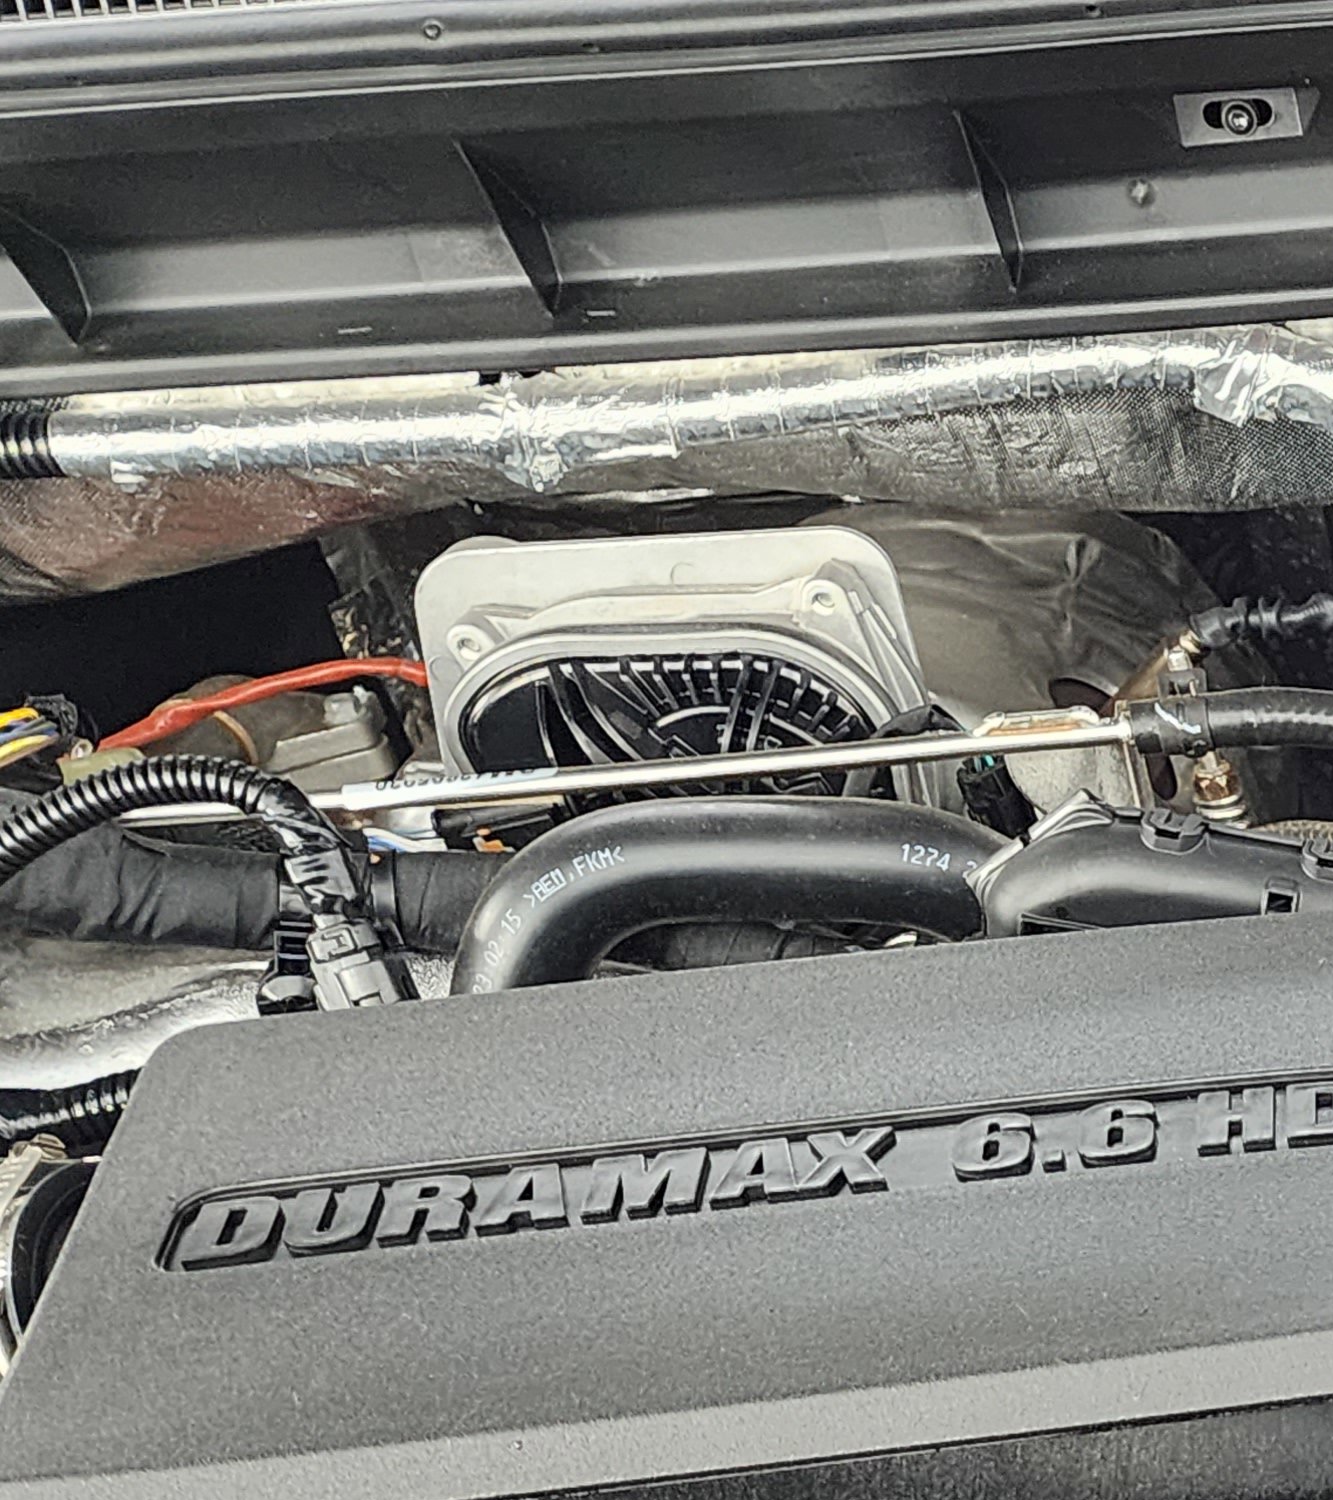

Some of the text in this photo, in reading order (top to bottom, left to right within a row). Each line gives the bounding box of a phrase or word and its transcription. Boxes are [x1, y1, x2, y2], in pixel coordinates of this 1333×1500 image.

[901, 843, 951, 872] 1274
[181, 1126, 896, 1272] DURAMAX
[952, 1100, 1160, 1184] 6.6
